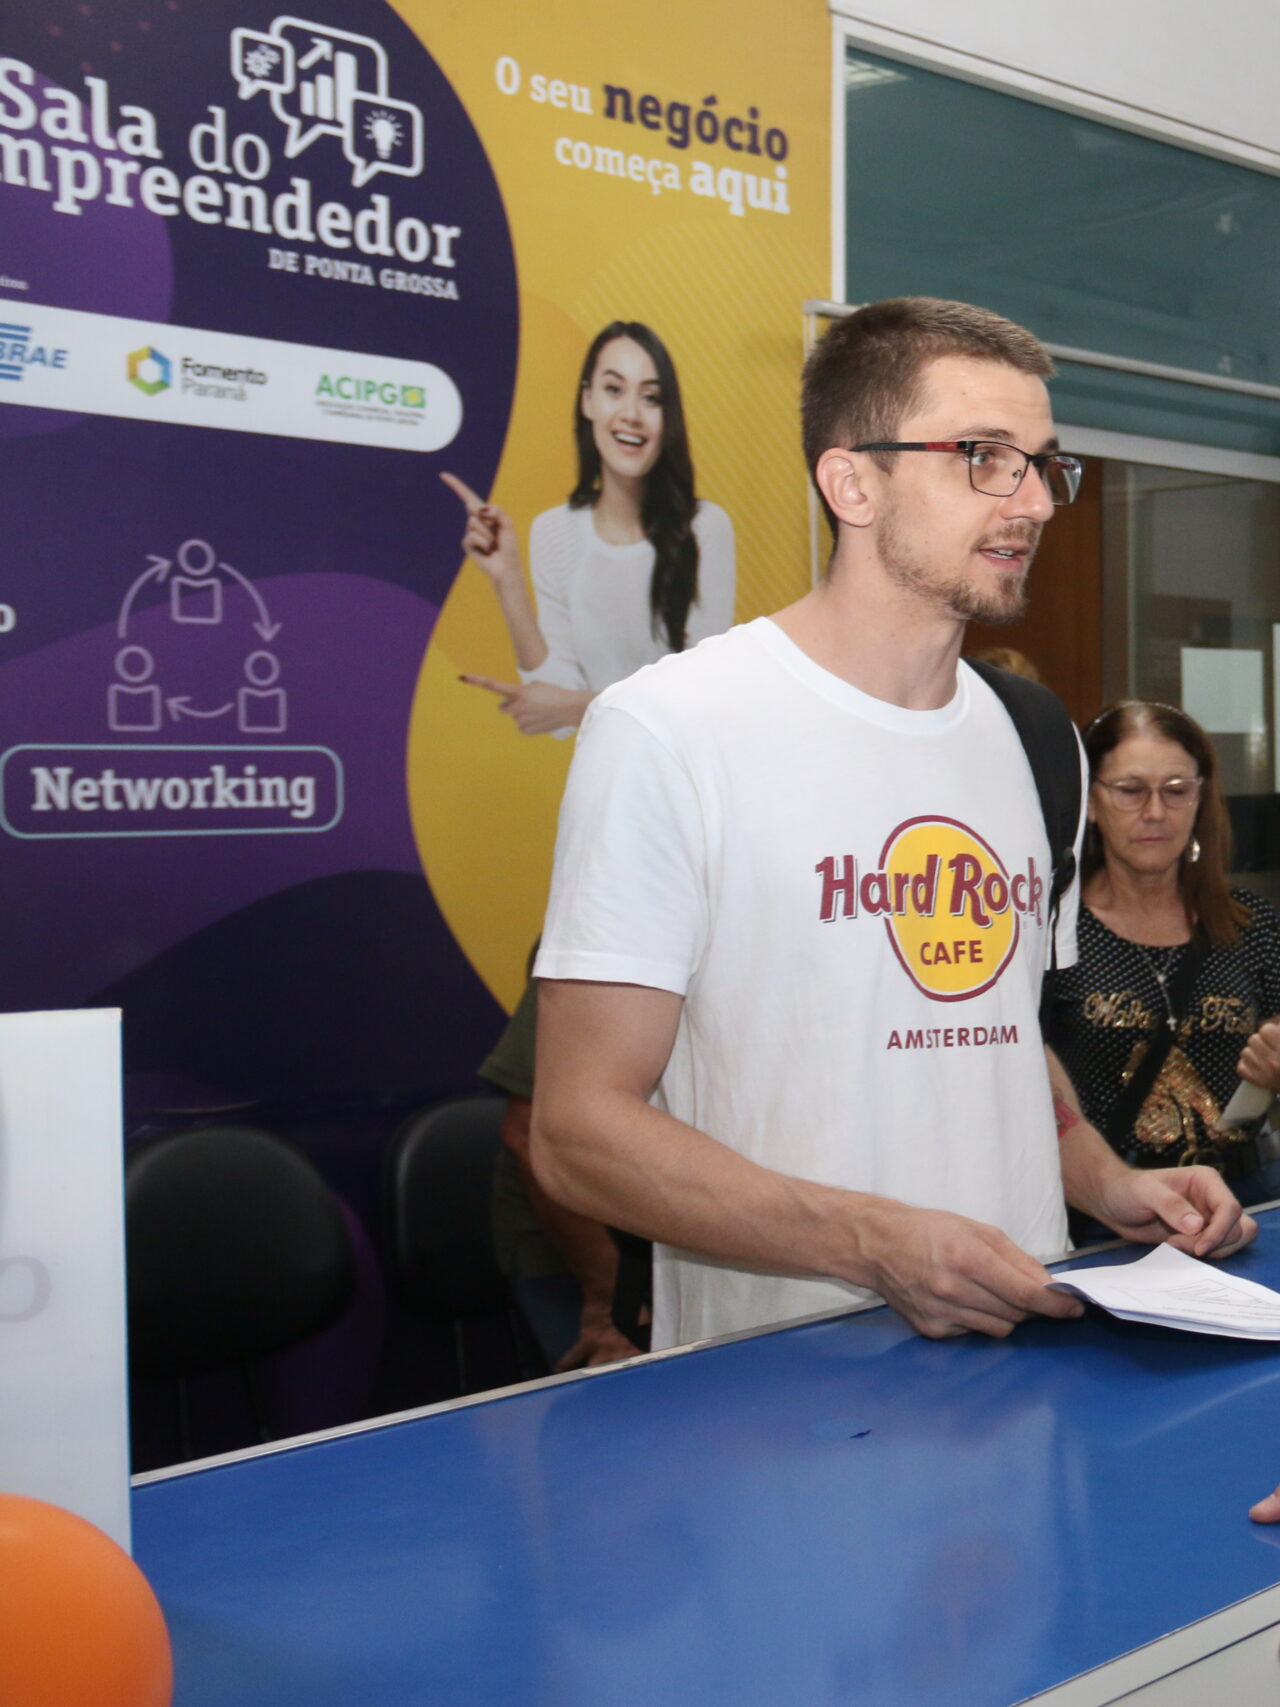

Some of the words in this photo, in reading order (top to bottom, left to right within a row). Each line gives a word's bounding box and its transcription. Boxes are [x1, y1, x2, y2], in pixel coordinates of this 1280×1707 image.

[0, 56, 164, 160] Sala
[189, 105, 271, 180] do
[495, 56, 521, 95] O
[530, 73, 593, 115] seu
[603, 83, 789, 162] negócio
[555, 137, 682, 195] começa
[690, 160, 791, 217] aqui
[269, 247, 301, 273] DE
[304, 256, 375, 287] PONTA
[380, 268, 459, 300] GROSSA
[181, 356, 268, 386] Fomento
[181, 377, 247, 402] Paraná
[315, 373, 398, 406] ACIPG
[31, 764, 316, 819] Networking
[815, 853, 942, 924] Hard
[947, 852, 1044, 930] Rock
[919, 939, 984, 966] CAFE
[886, 1024, 1019, 1050] AMSTERDAM
